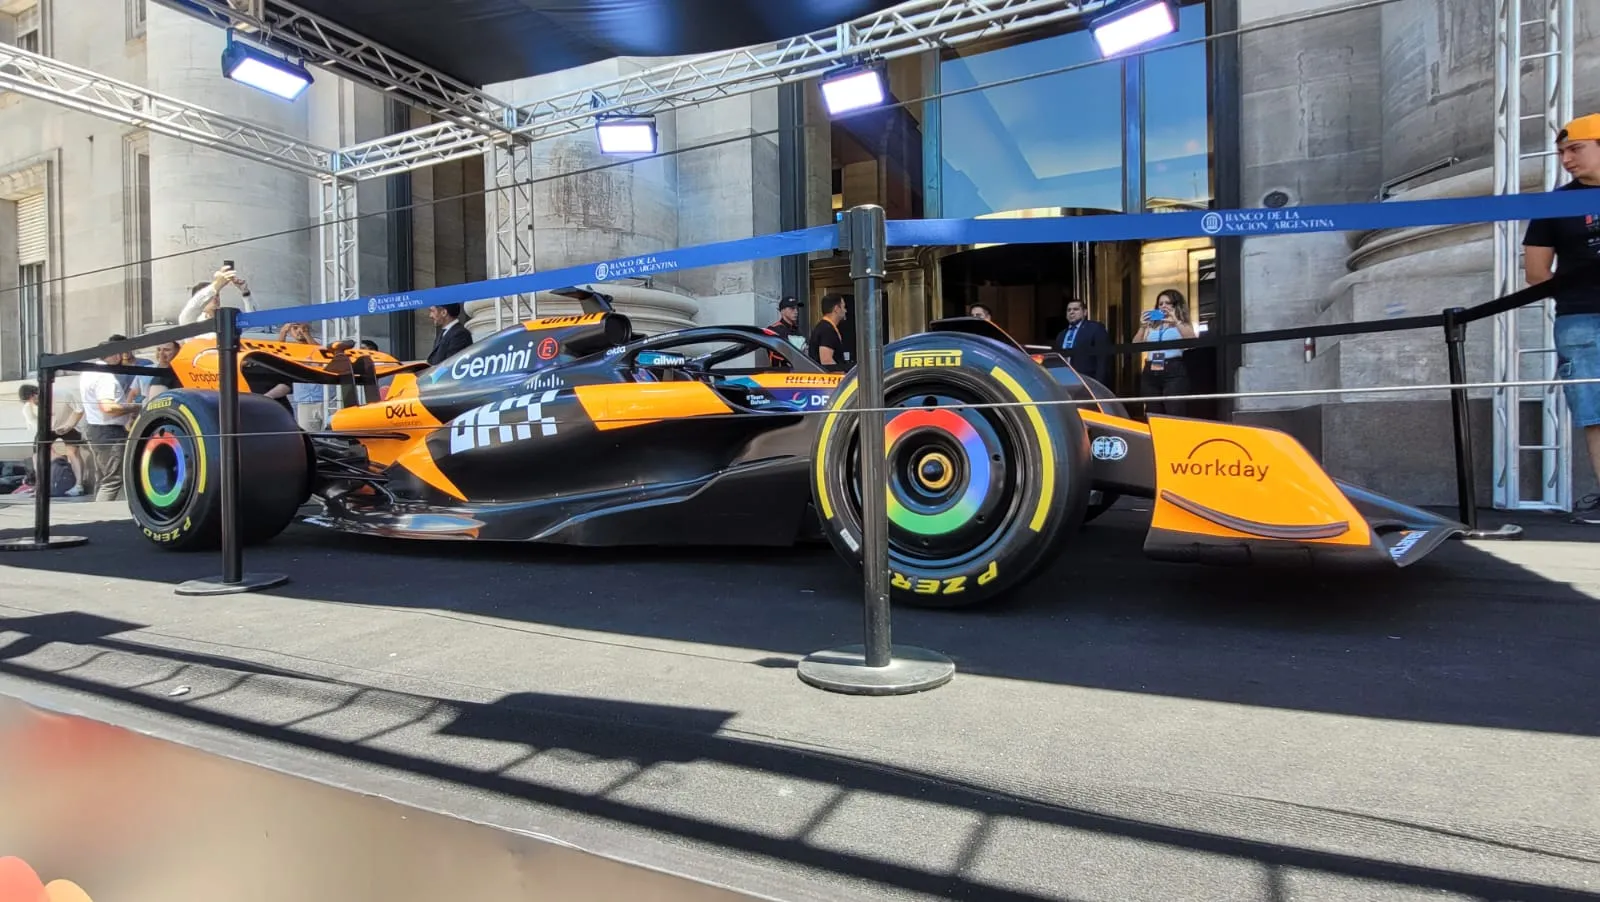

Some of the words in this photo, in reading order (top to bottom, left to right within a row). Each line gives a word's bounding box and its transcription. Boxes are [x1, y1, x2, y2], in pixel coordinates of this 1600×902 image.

[1225, 213, 1264, 222] BANCO
[1267, 211, 1281, 220] DE
[1285, 211, 1300, 220] LA
[1273, 219, 1335, 230] ARGENTINA
[609, 259, 634, 270] BANCO
[635, 258, 645, 266] DE
[647, 256, 656, 264] LA
[638, 260, 678, 273] ARGENTINA
[451, 341, 534, 380] Gemini
[893, 349, 963, 368] PIRELLI
[386, 403, 418, 419] DELL
[1170, 459, 1269, 482] workday
[977, 560, 998, 586] P
[891, 572, 967, 594] ZER
